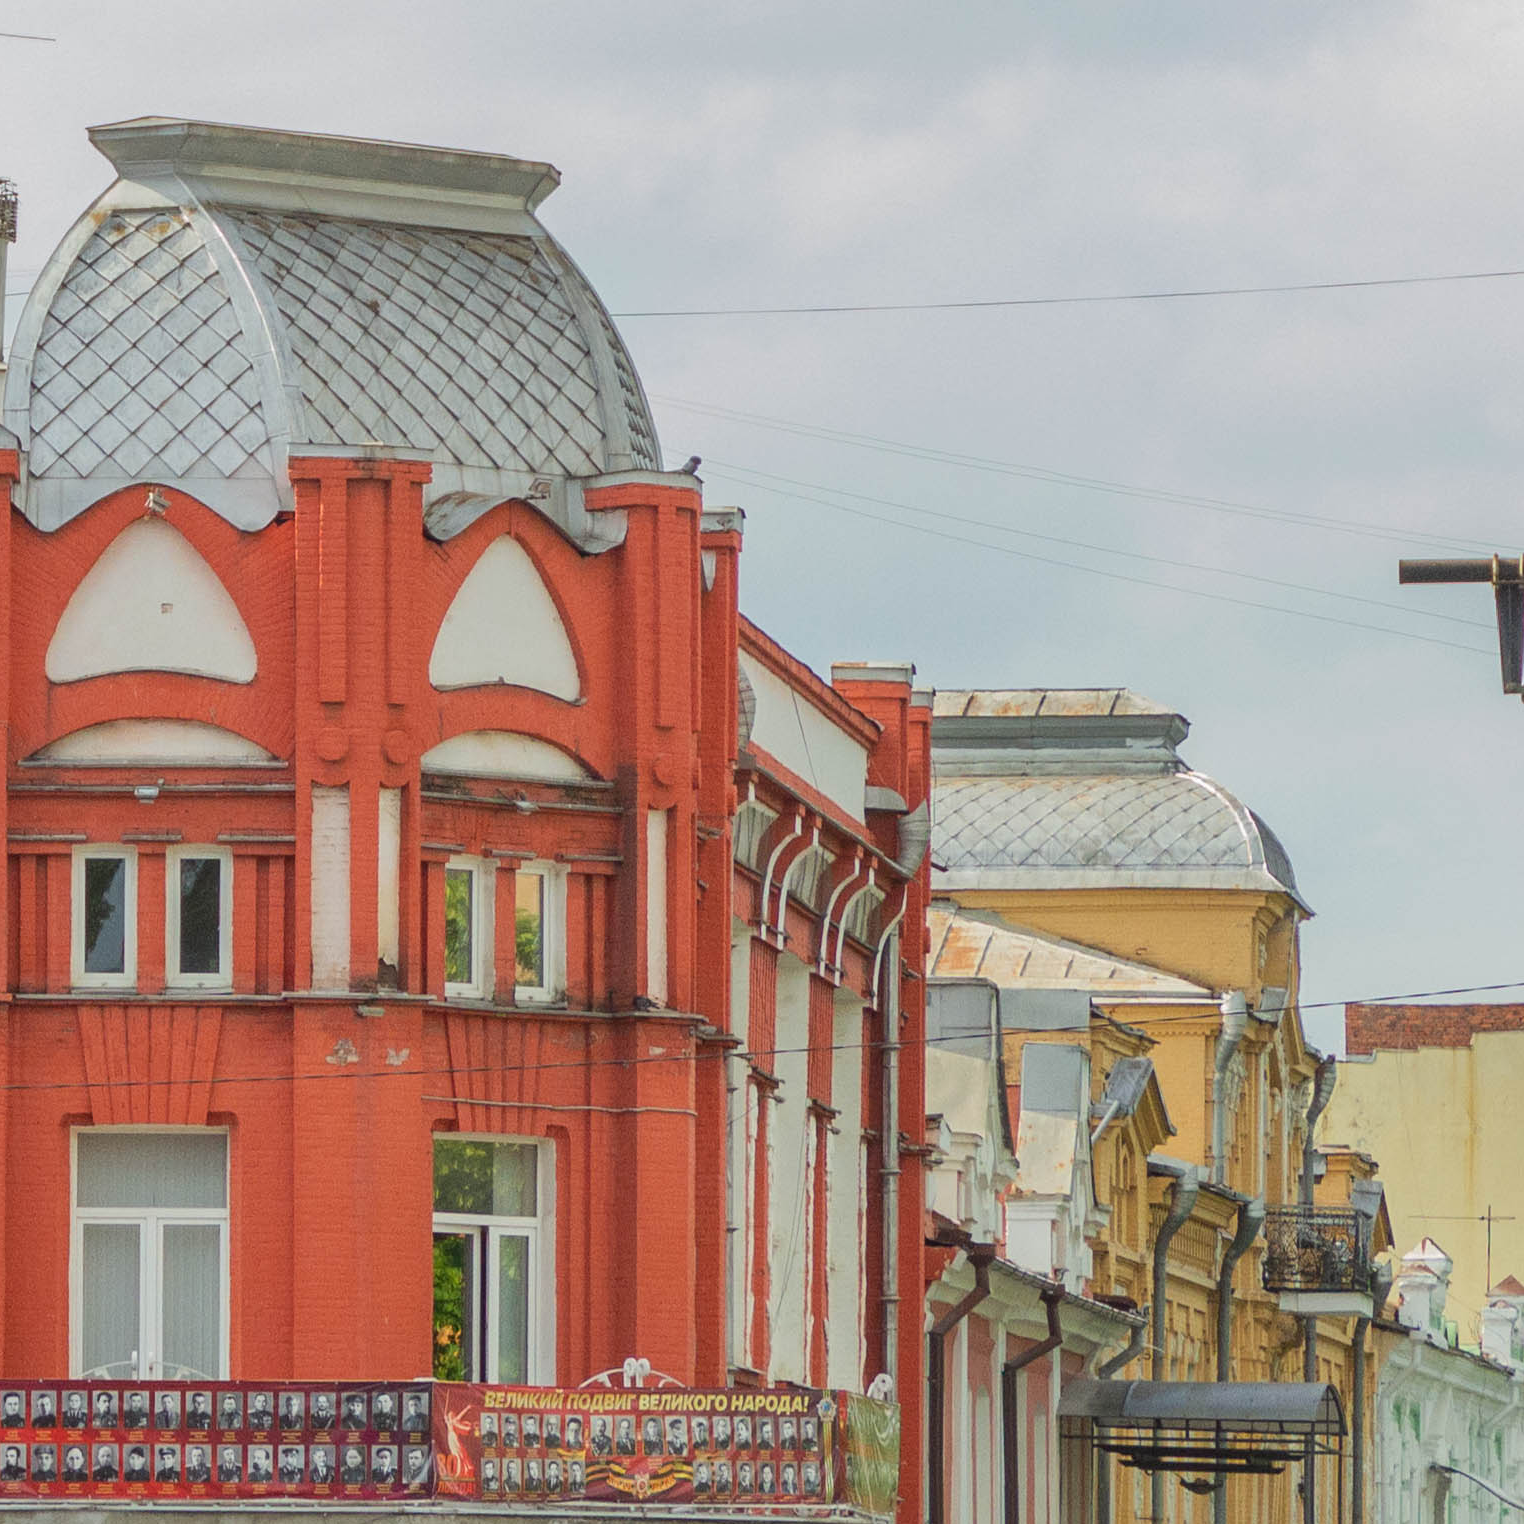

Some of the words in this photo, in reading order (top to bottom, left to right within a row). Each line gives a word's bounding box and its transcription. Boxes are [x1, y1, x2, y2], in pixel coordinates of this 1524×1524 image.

[484, 1388, 565, 1409] ВЕЛИКИЙ
[566, 1394, 637, 1413] ПОДВИГ
[638, 1394, 727, 1412] ВЕЛИКОГО
[730, 1394, 809, 1415] НАРОДА!
